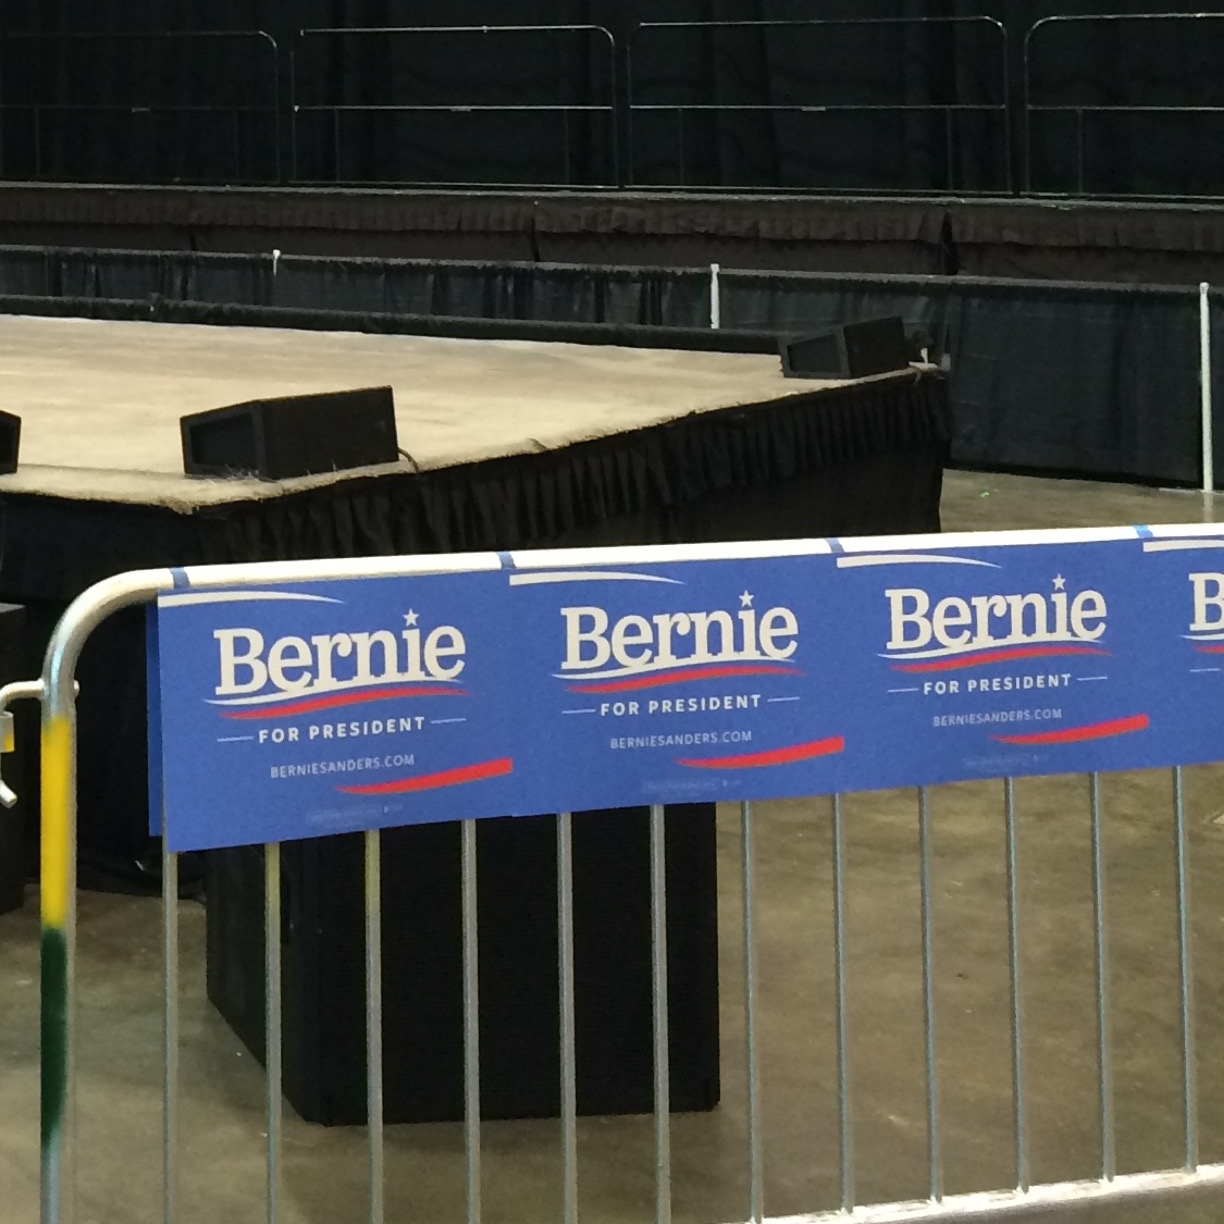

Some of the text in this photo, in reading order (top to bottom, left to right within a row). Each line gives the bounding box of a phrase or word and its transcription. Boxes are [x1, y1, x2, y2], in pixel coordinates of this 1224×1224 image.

[885, 574, 1107, 649] Bernie
[560, 590, 798, 669] Bernie
[213, 608, 466, 695] Bernie
[922, 673, 1072, 695] FOR PRESIDENT
[600, 694, 762, 717] FOR PRESIDENT
[932, 708, 1062, 727] BERNIESANDERS.COM
[258, 716, 425, 744] FOR PRESIDENT
[610, 730, 753, 750] BERNIESANDERS.COM
[270, 754, 415, 779] BERNIESANDERS.COM
